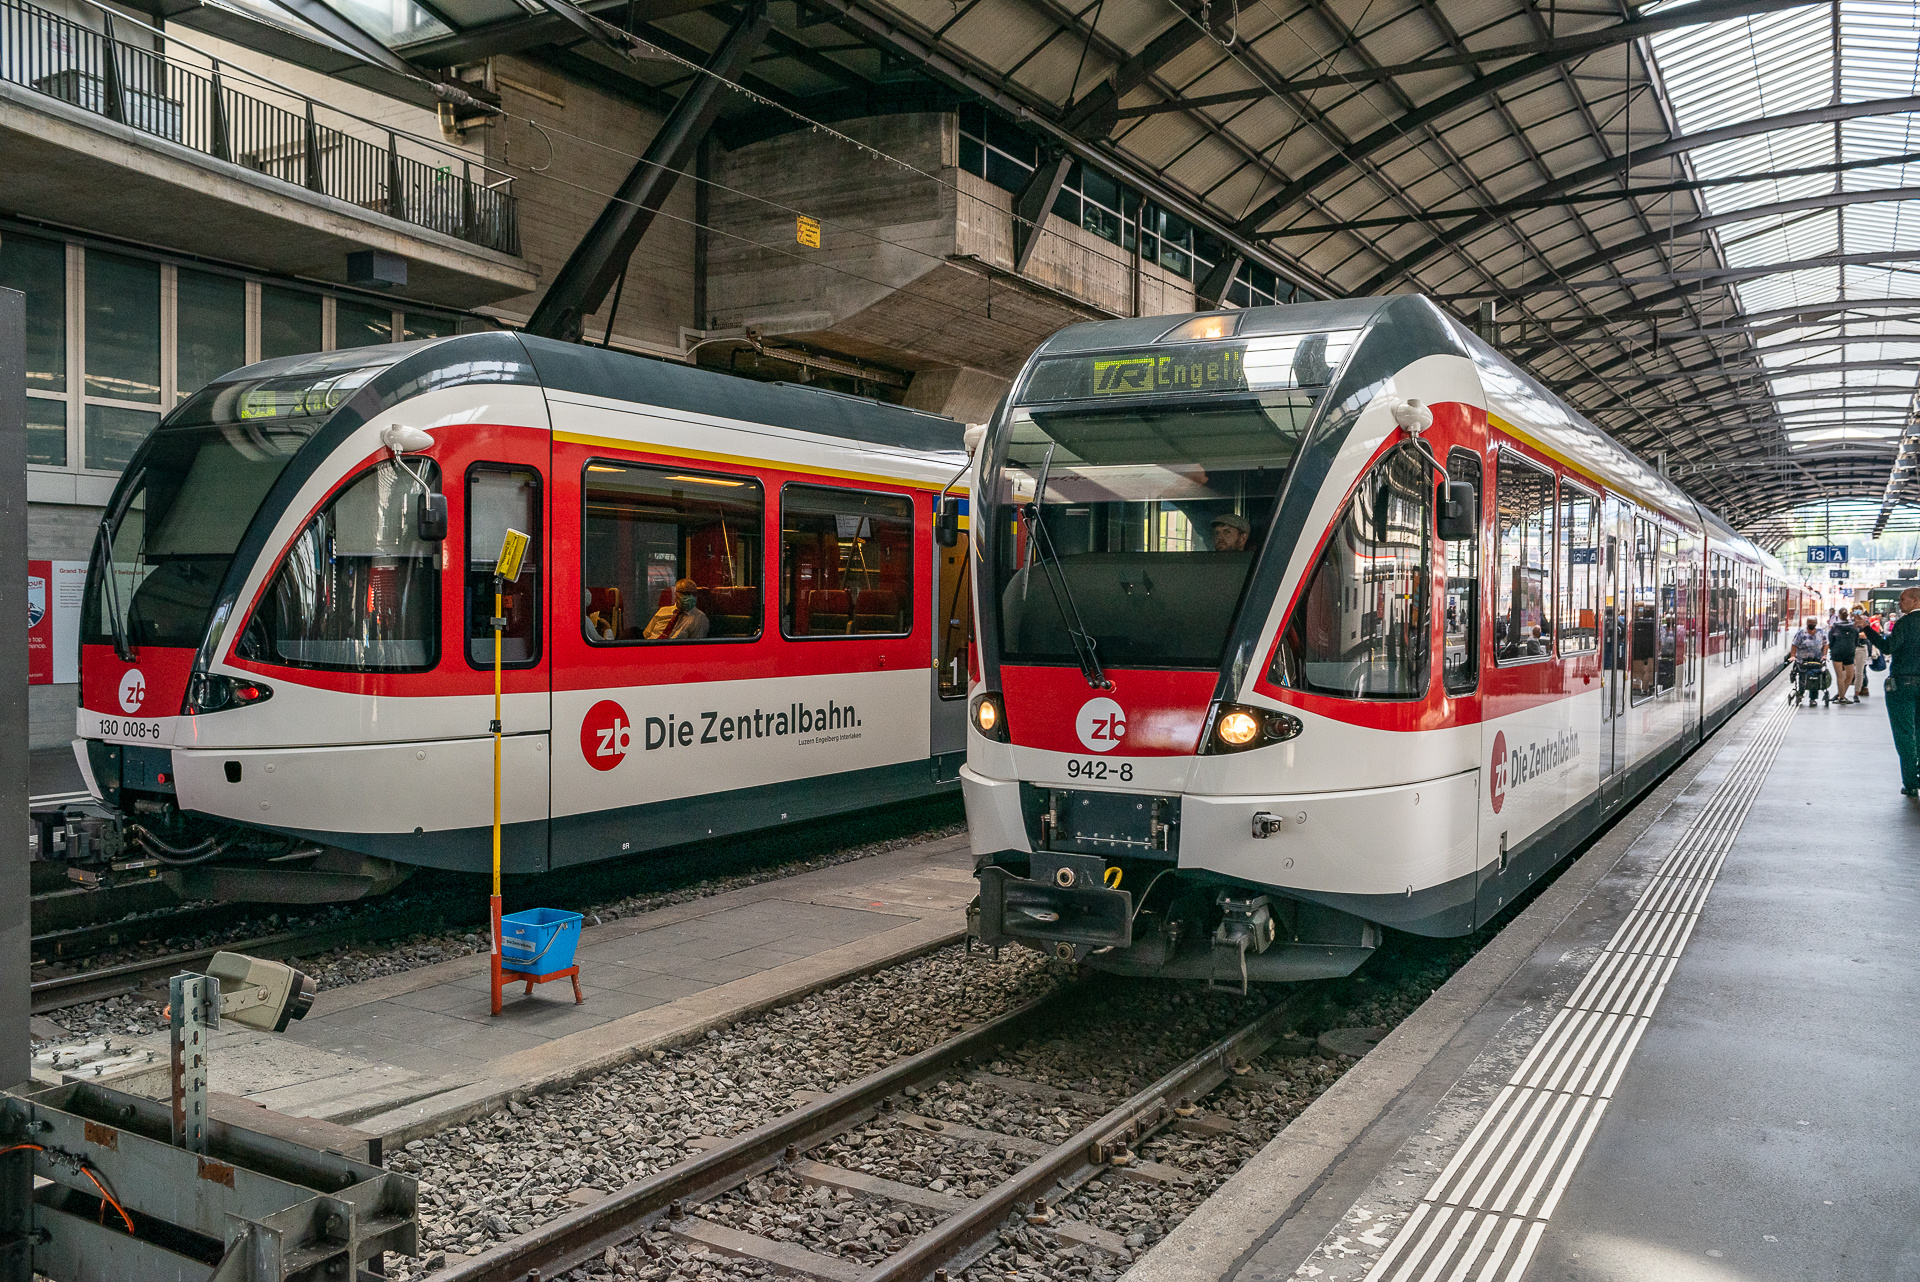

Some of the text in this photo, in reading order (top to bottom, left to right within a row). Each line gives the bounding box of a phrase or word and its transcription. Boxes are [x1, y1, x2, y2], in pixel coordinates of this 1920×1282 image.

[1810, 550, 1843, 561] 13 A
[949, 657, 958, 686] 1
[125, 681, 146, 705] zb
[99, 719, 160, 739] 130 008-6
[596, 718, 631, 757] zb
[645, 700, 862, 751] Die Zentralbahn.
[1091, 712, 1128, 742] zb
[1067, 759, 1133, 782] 942-8
[1511, 726, 1580, 789] Die Zentralbahn.
